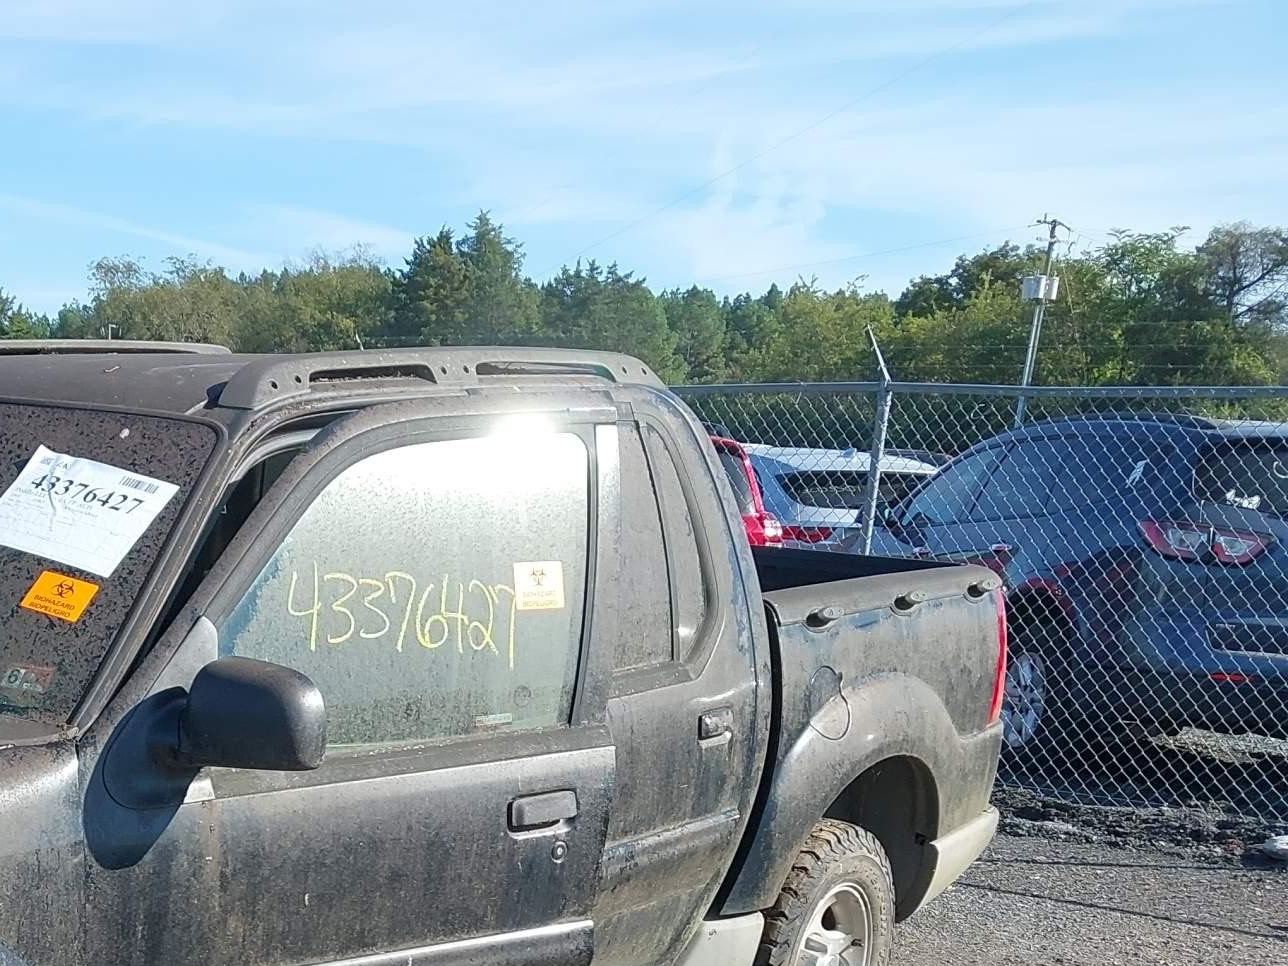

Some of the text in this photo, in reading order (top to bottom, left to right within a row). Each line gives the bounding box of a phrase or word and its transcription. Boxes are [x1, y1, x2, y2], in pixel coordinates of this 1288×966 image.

[31, 474, 145, 514] 43376427
[29, 602, 71, 617] BIOPELIGRO
[34, 594, 75, 611] BIOHAZARD
[288, 559, 516, 671] 43376427
